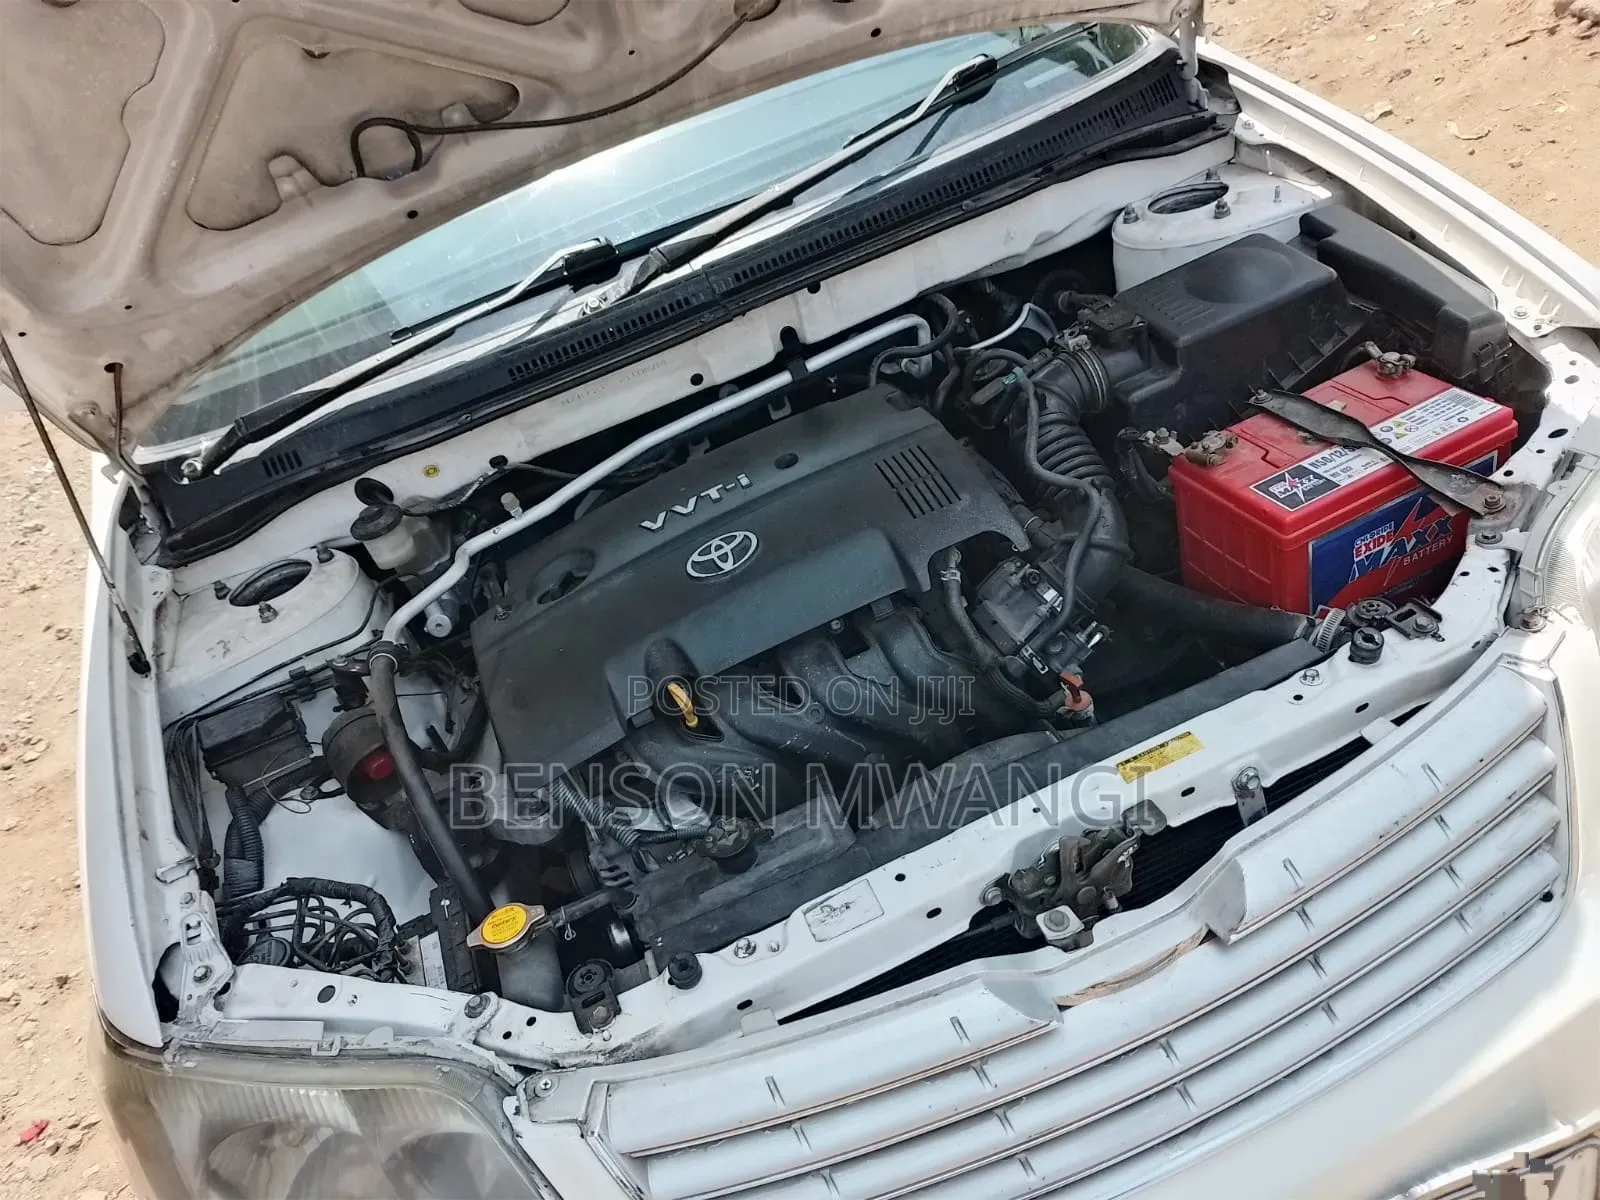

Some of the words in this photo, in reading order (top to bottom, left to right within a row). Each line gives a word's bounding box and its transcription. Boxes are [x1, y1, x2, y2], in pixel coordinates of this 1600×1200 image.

[639, 473, 752, 533] VVT-i
[1354, 521, 1395, 547] CHLORIDE
[1355, 530, 1395, 559] EXIDE
[1349, 516, 1454, 584] MAXX
[1403, 535, 1454, 566] BATTERY
